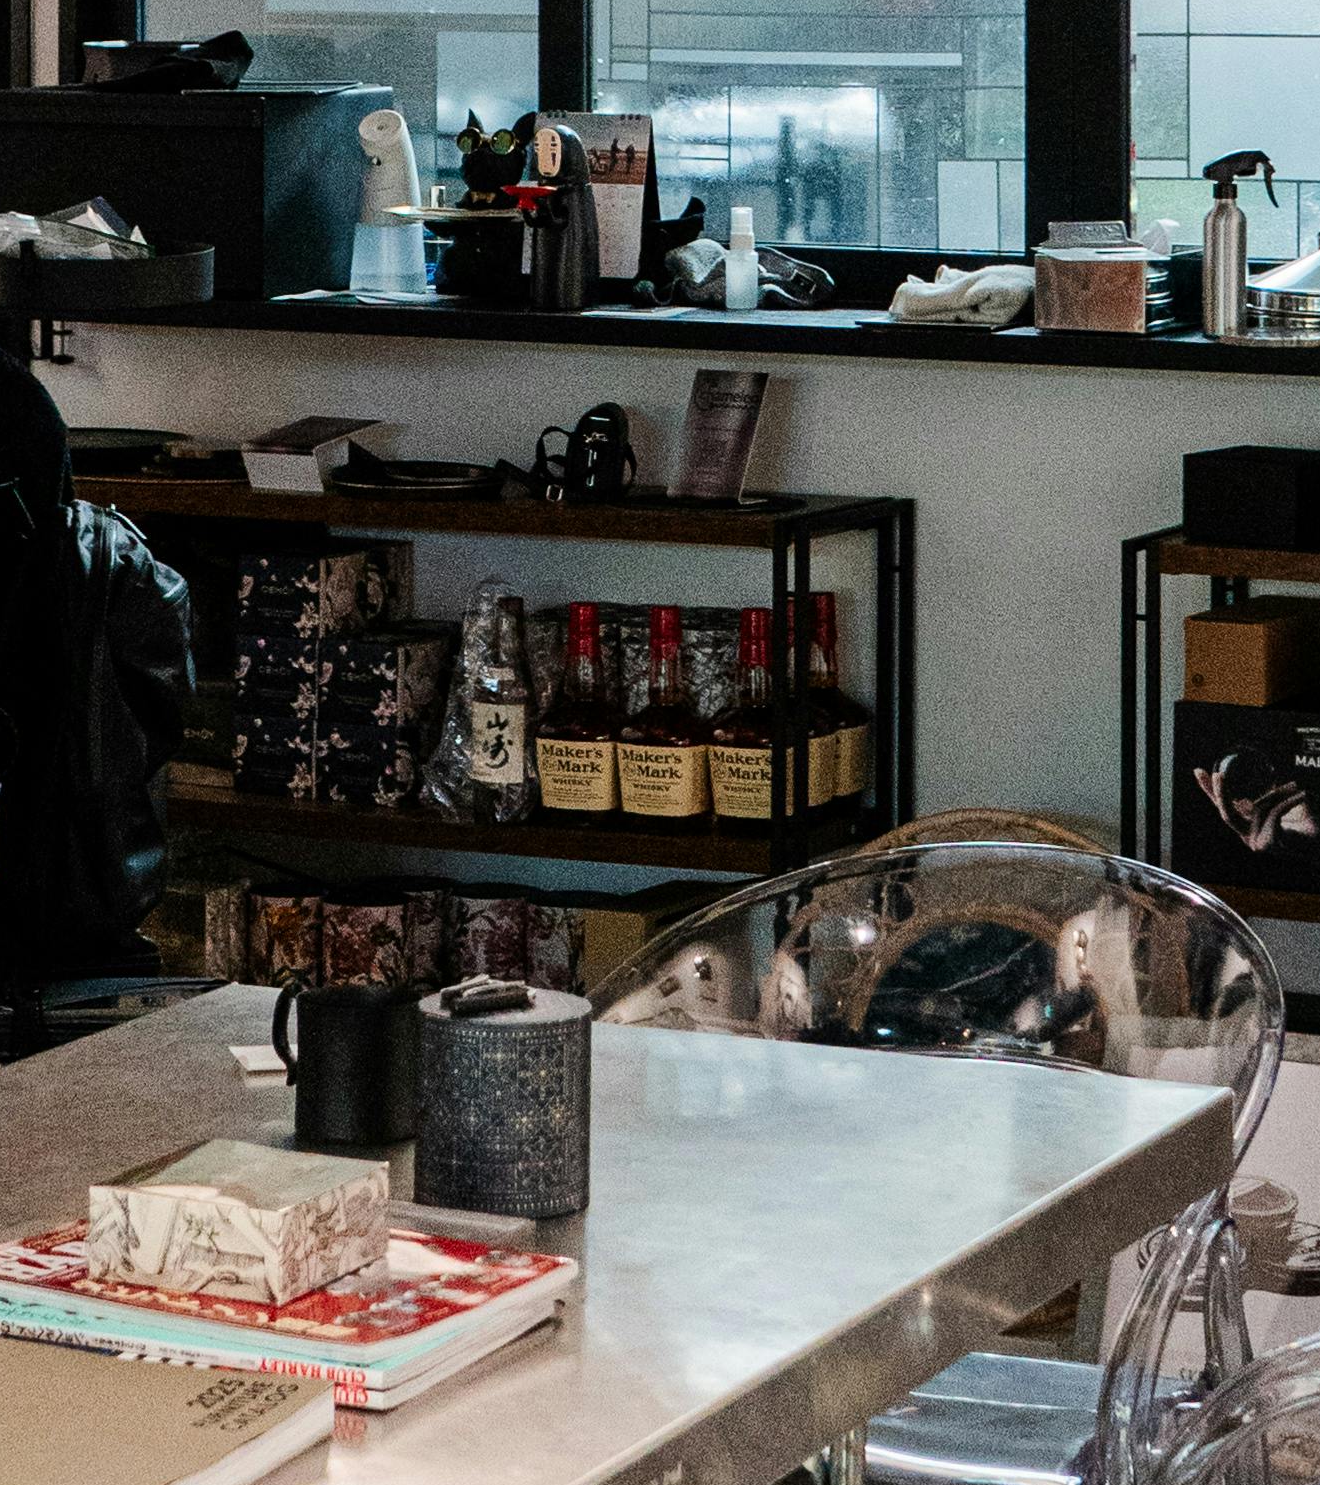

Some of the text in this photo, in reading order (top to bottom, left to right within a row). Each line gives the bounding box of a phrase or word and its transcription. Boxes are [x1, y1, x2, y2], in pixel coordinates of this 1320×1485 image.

[542, 743, 604, 759] Maker's
[622, 749, 683, 765] Maker's
[712, 749, 772, 767] Maker's
[558, 759, 603, 774] Mark
[637, 764, 683, 779] Mark
[728, 766, 772, 782] Mark
[552, 777, 592, 787] WHISKY
[260, 1358, 367, 1384] CLUB HARLEY
[186, 1378, 246, 1409] 2025
[333, 1383, 369, 1406] CLU
[190, 1381, 274, 1428] FURNITURE
[219, 1383, 299, 1431] CATALOG
